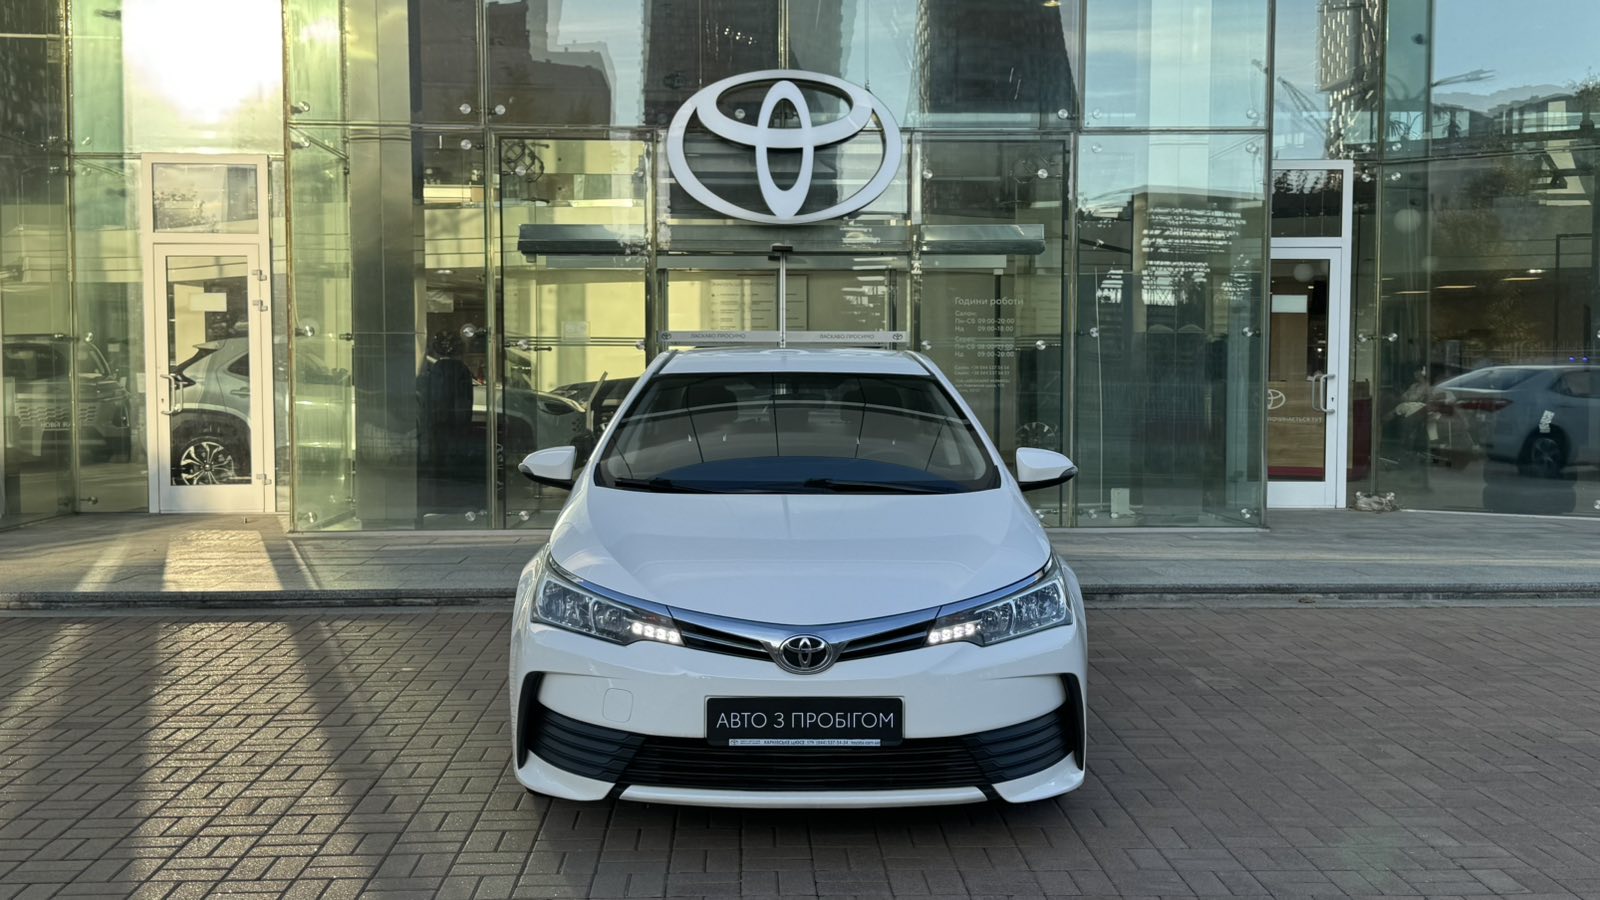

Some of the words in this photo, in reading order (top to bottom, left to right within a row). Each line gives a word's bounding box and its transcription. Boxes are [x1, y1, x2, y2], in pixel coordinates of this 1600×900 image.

[955, 296, 988, 306] Години
[990, 296, 1024, 307] роботи
[716, 712, 767, 729] АВТО
[773, 712, 785, 729] З
[791, 712, 894, 729] ПРОБІГОМ
